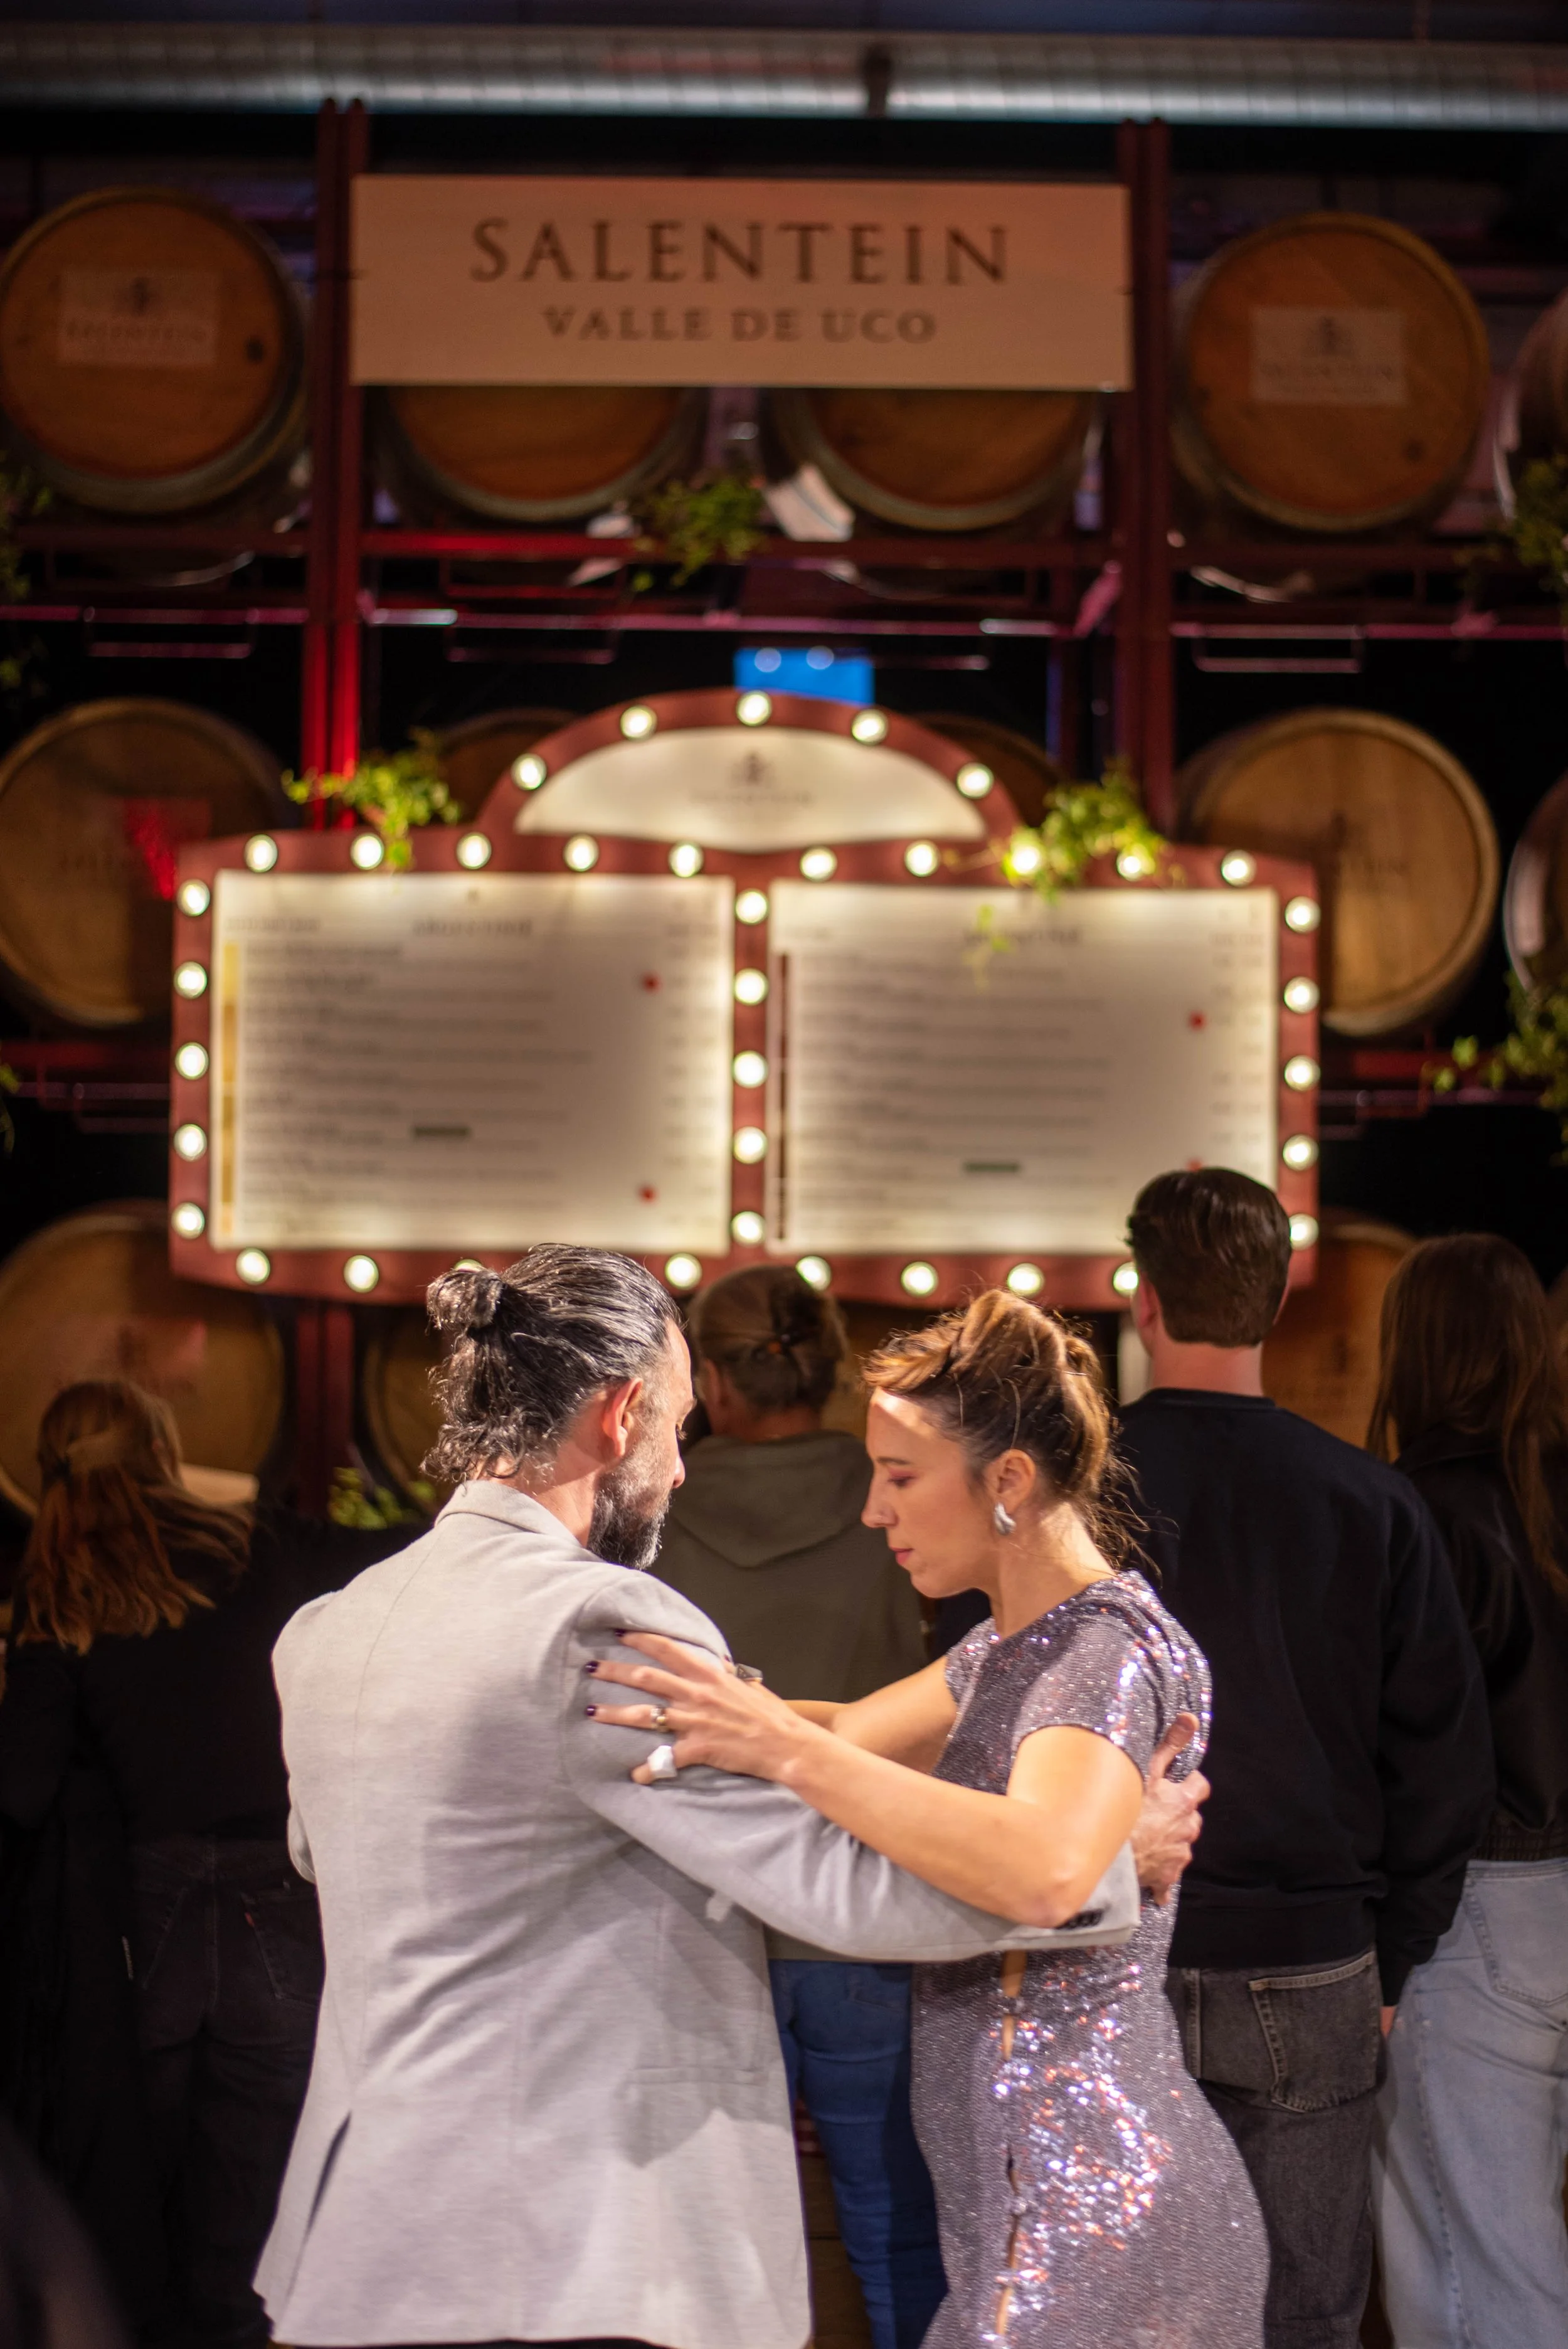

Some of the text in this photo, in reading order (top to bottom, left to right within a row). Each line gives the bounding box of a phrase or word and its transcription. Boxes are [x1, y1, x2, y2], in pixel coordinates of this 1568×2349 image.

[470, 217, 1007, 287] SALENTEIN
[543, 306, 936, 344] VALLE DE UCO
